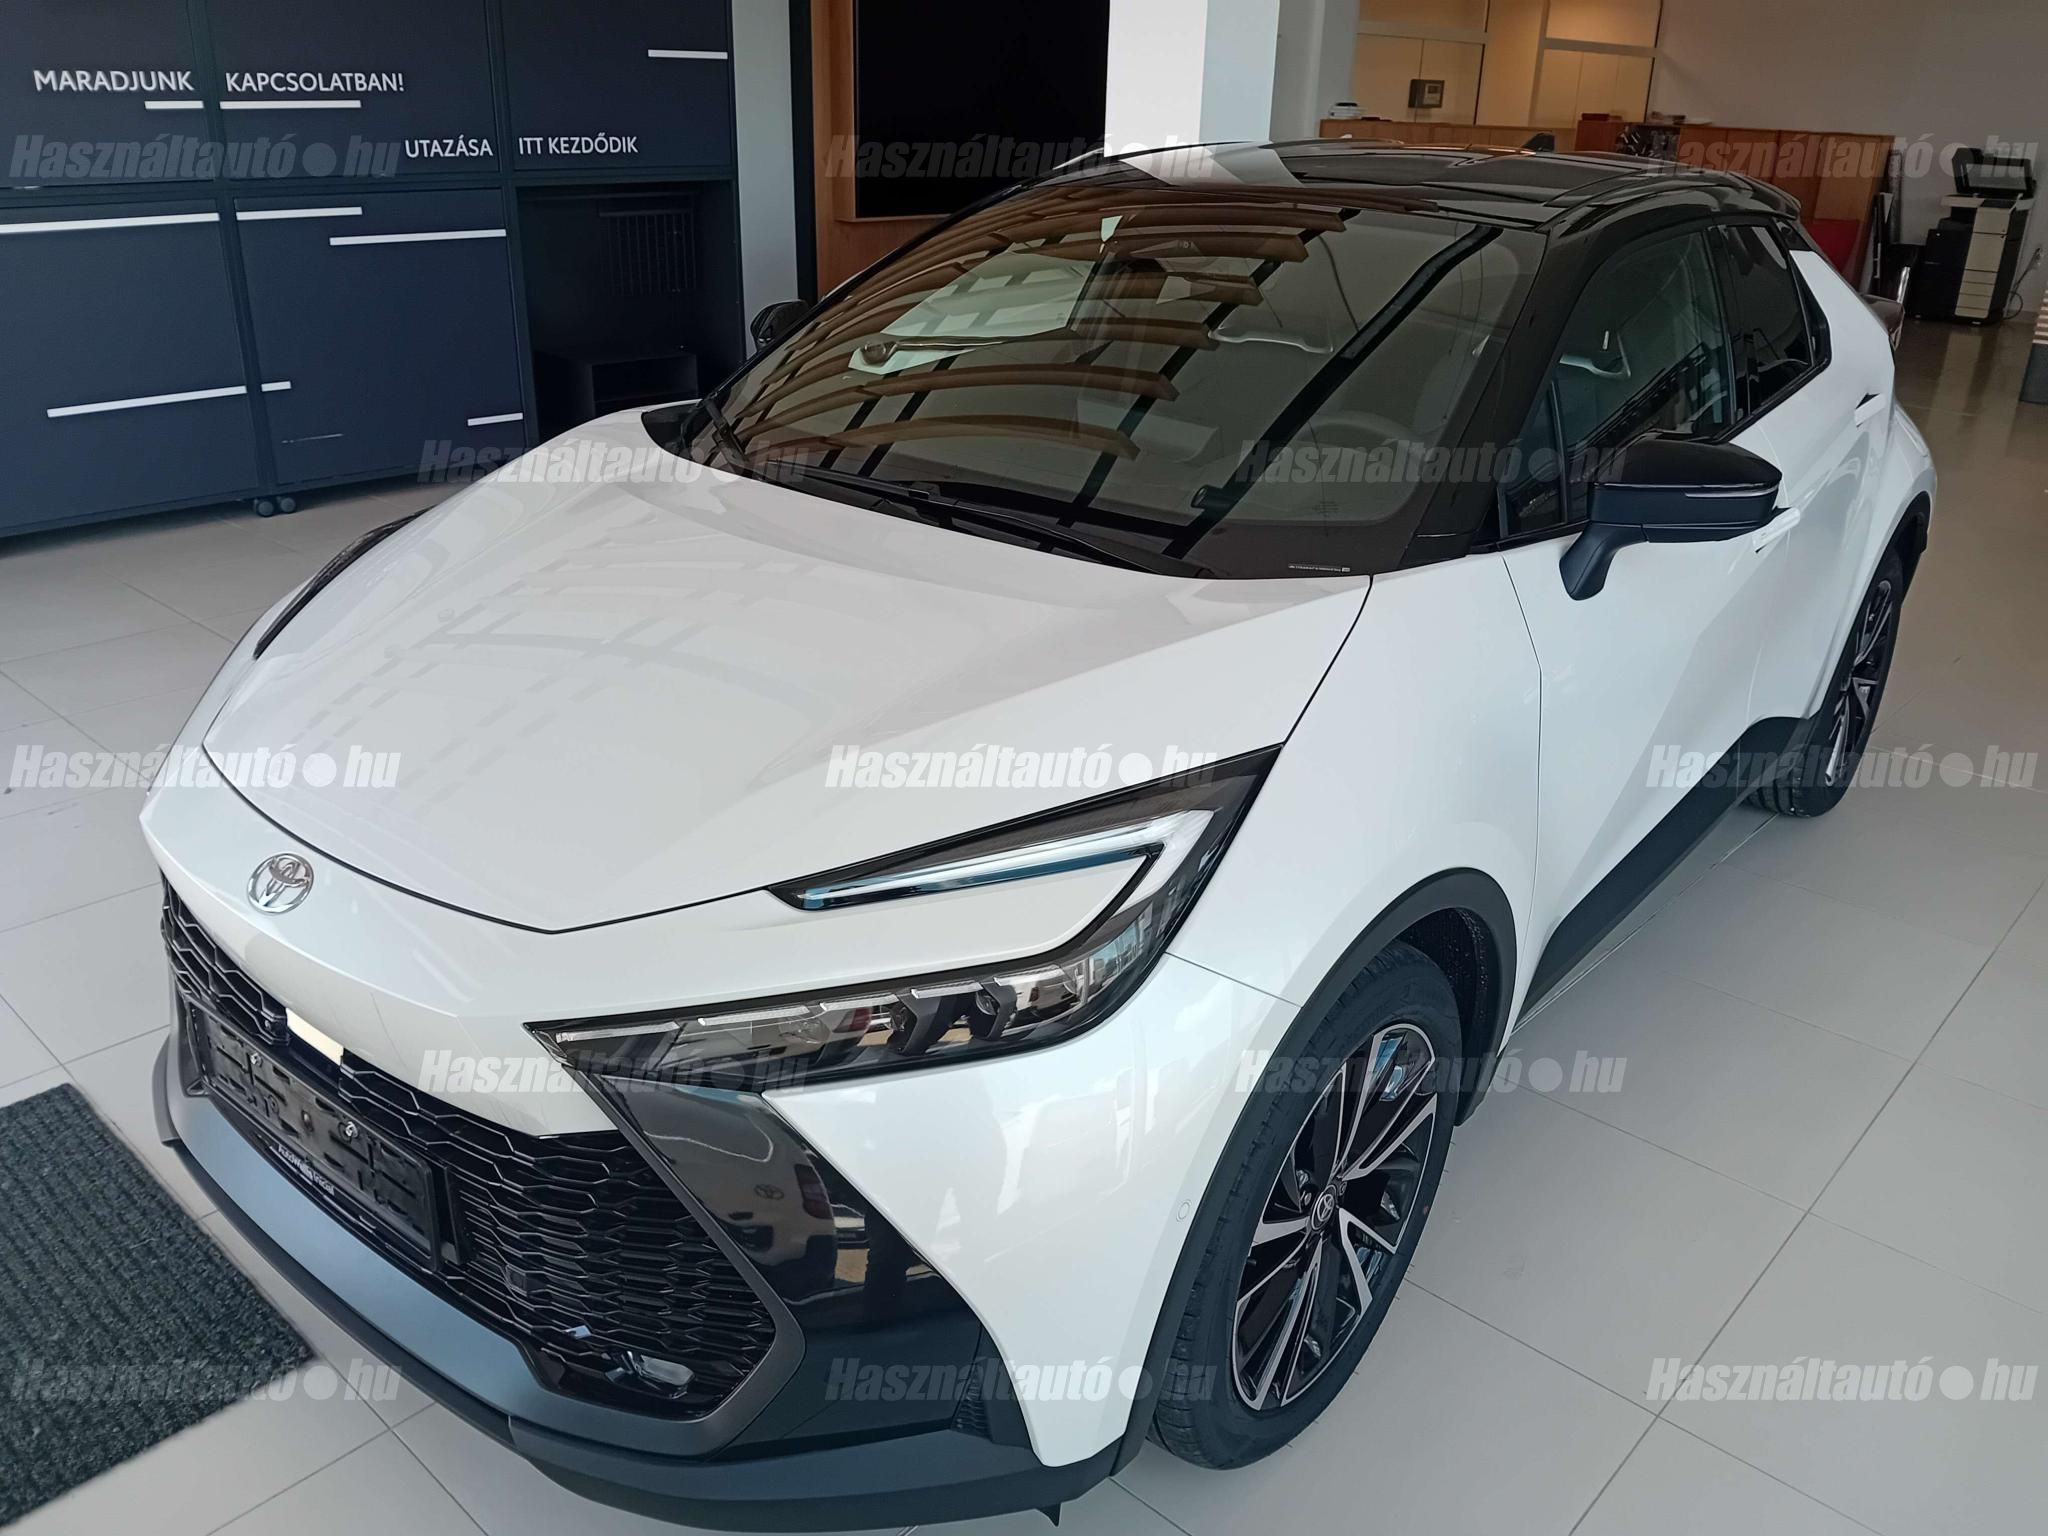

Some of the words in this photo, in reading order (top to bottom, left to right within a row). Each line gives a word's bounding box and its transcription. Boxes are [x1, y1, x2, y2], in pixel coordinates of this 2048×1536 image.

[33, 70, 194, 92] MARADJUNK
[225, 72, 404, 92] KAPCSOLATBAN!
[405, 134, 494, 158] UTAZÁSA
[518, 137, 543, 155] ITT
[548, 132, 639, 155] KEZDŐDIK
